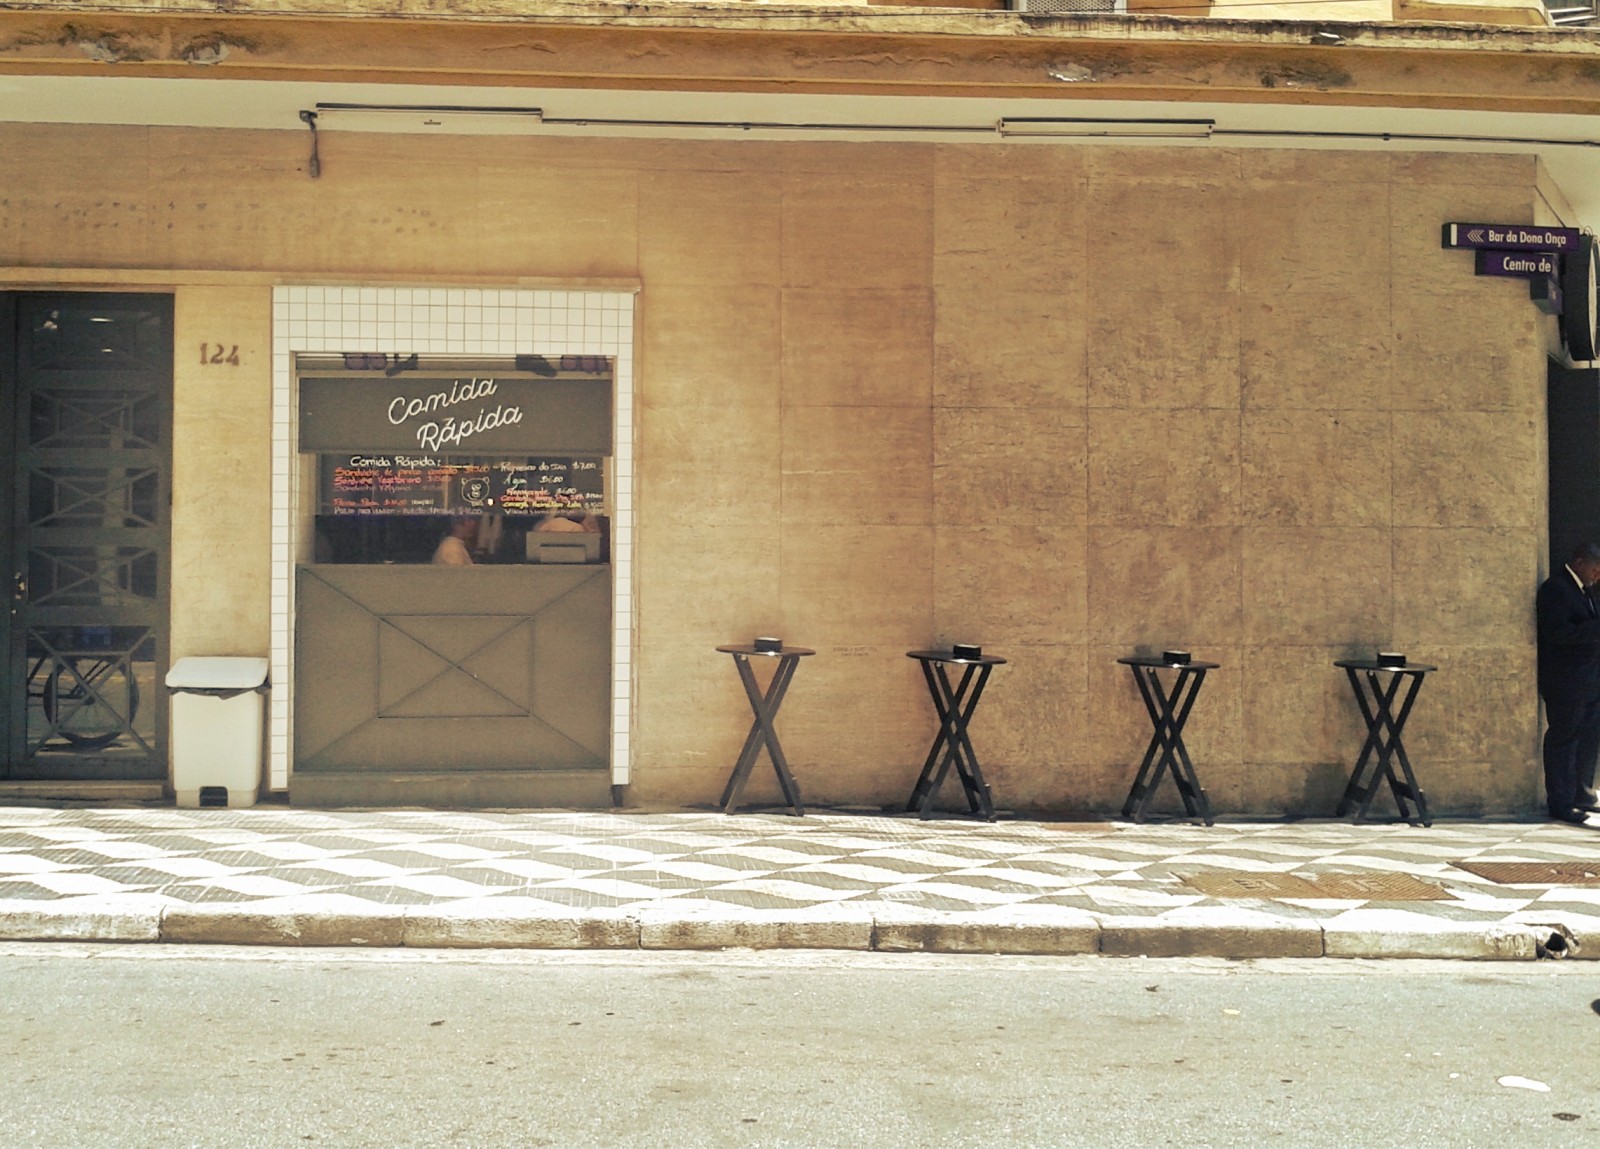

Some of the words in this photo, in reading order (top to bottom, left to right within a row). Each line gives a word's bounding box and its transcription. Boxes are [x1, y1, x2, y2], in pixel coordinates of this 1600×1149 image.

[1488, 230, 1504, 243] Bar
[1506, 231, 1518, 243] da
[1520, 232, 1543, 244] Dona
[1545, 232, 1567, 247] Onça
[1503, 256, 1536, 272] Centro
[1538, 258, 1552, 273] de
[200, 342, 240, 366] 124
[388, 377, 497, 425] Comida
[416, 404, 523, 452] Rápida
[350, 456, 391, 467] Comida
